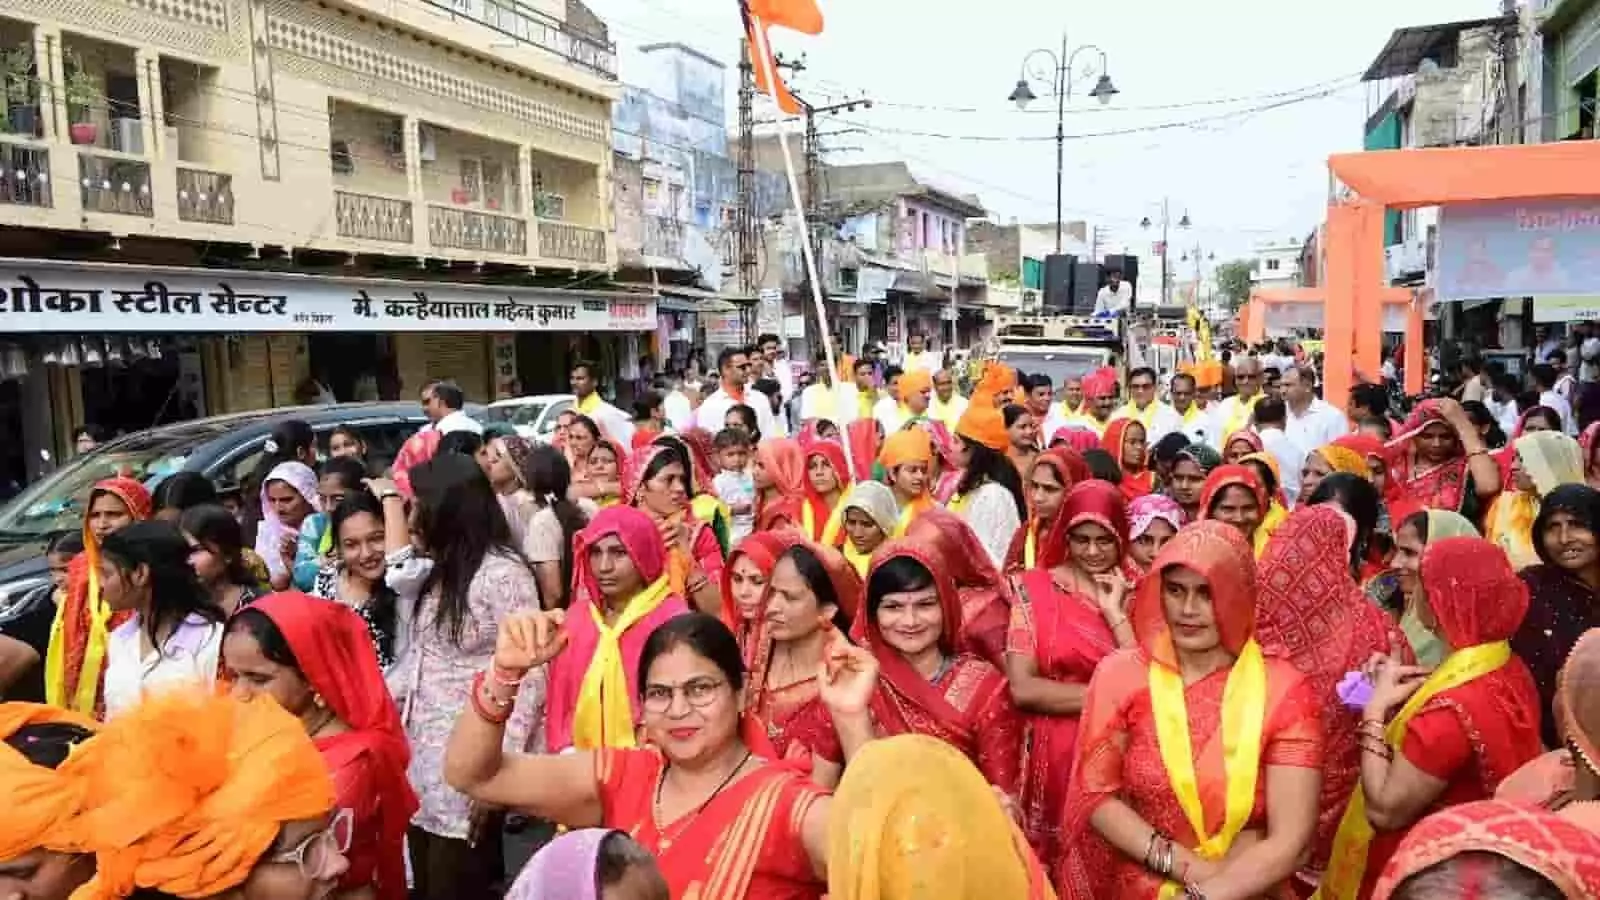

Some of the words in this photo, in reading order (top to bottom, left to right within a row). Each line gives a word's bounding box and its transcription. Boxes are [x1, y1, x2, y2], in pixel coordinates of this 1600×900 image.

[112, 280, 203, 315] स्टील
[208, 282, 288, 315] सेन्टर
[384, 292, 489, 320] कन्हैयालाल
[537, 302, 577, 326] कुमार
